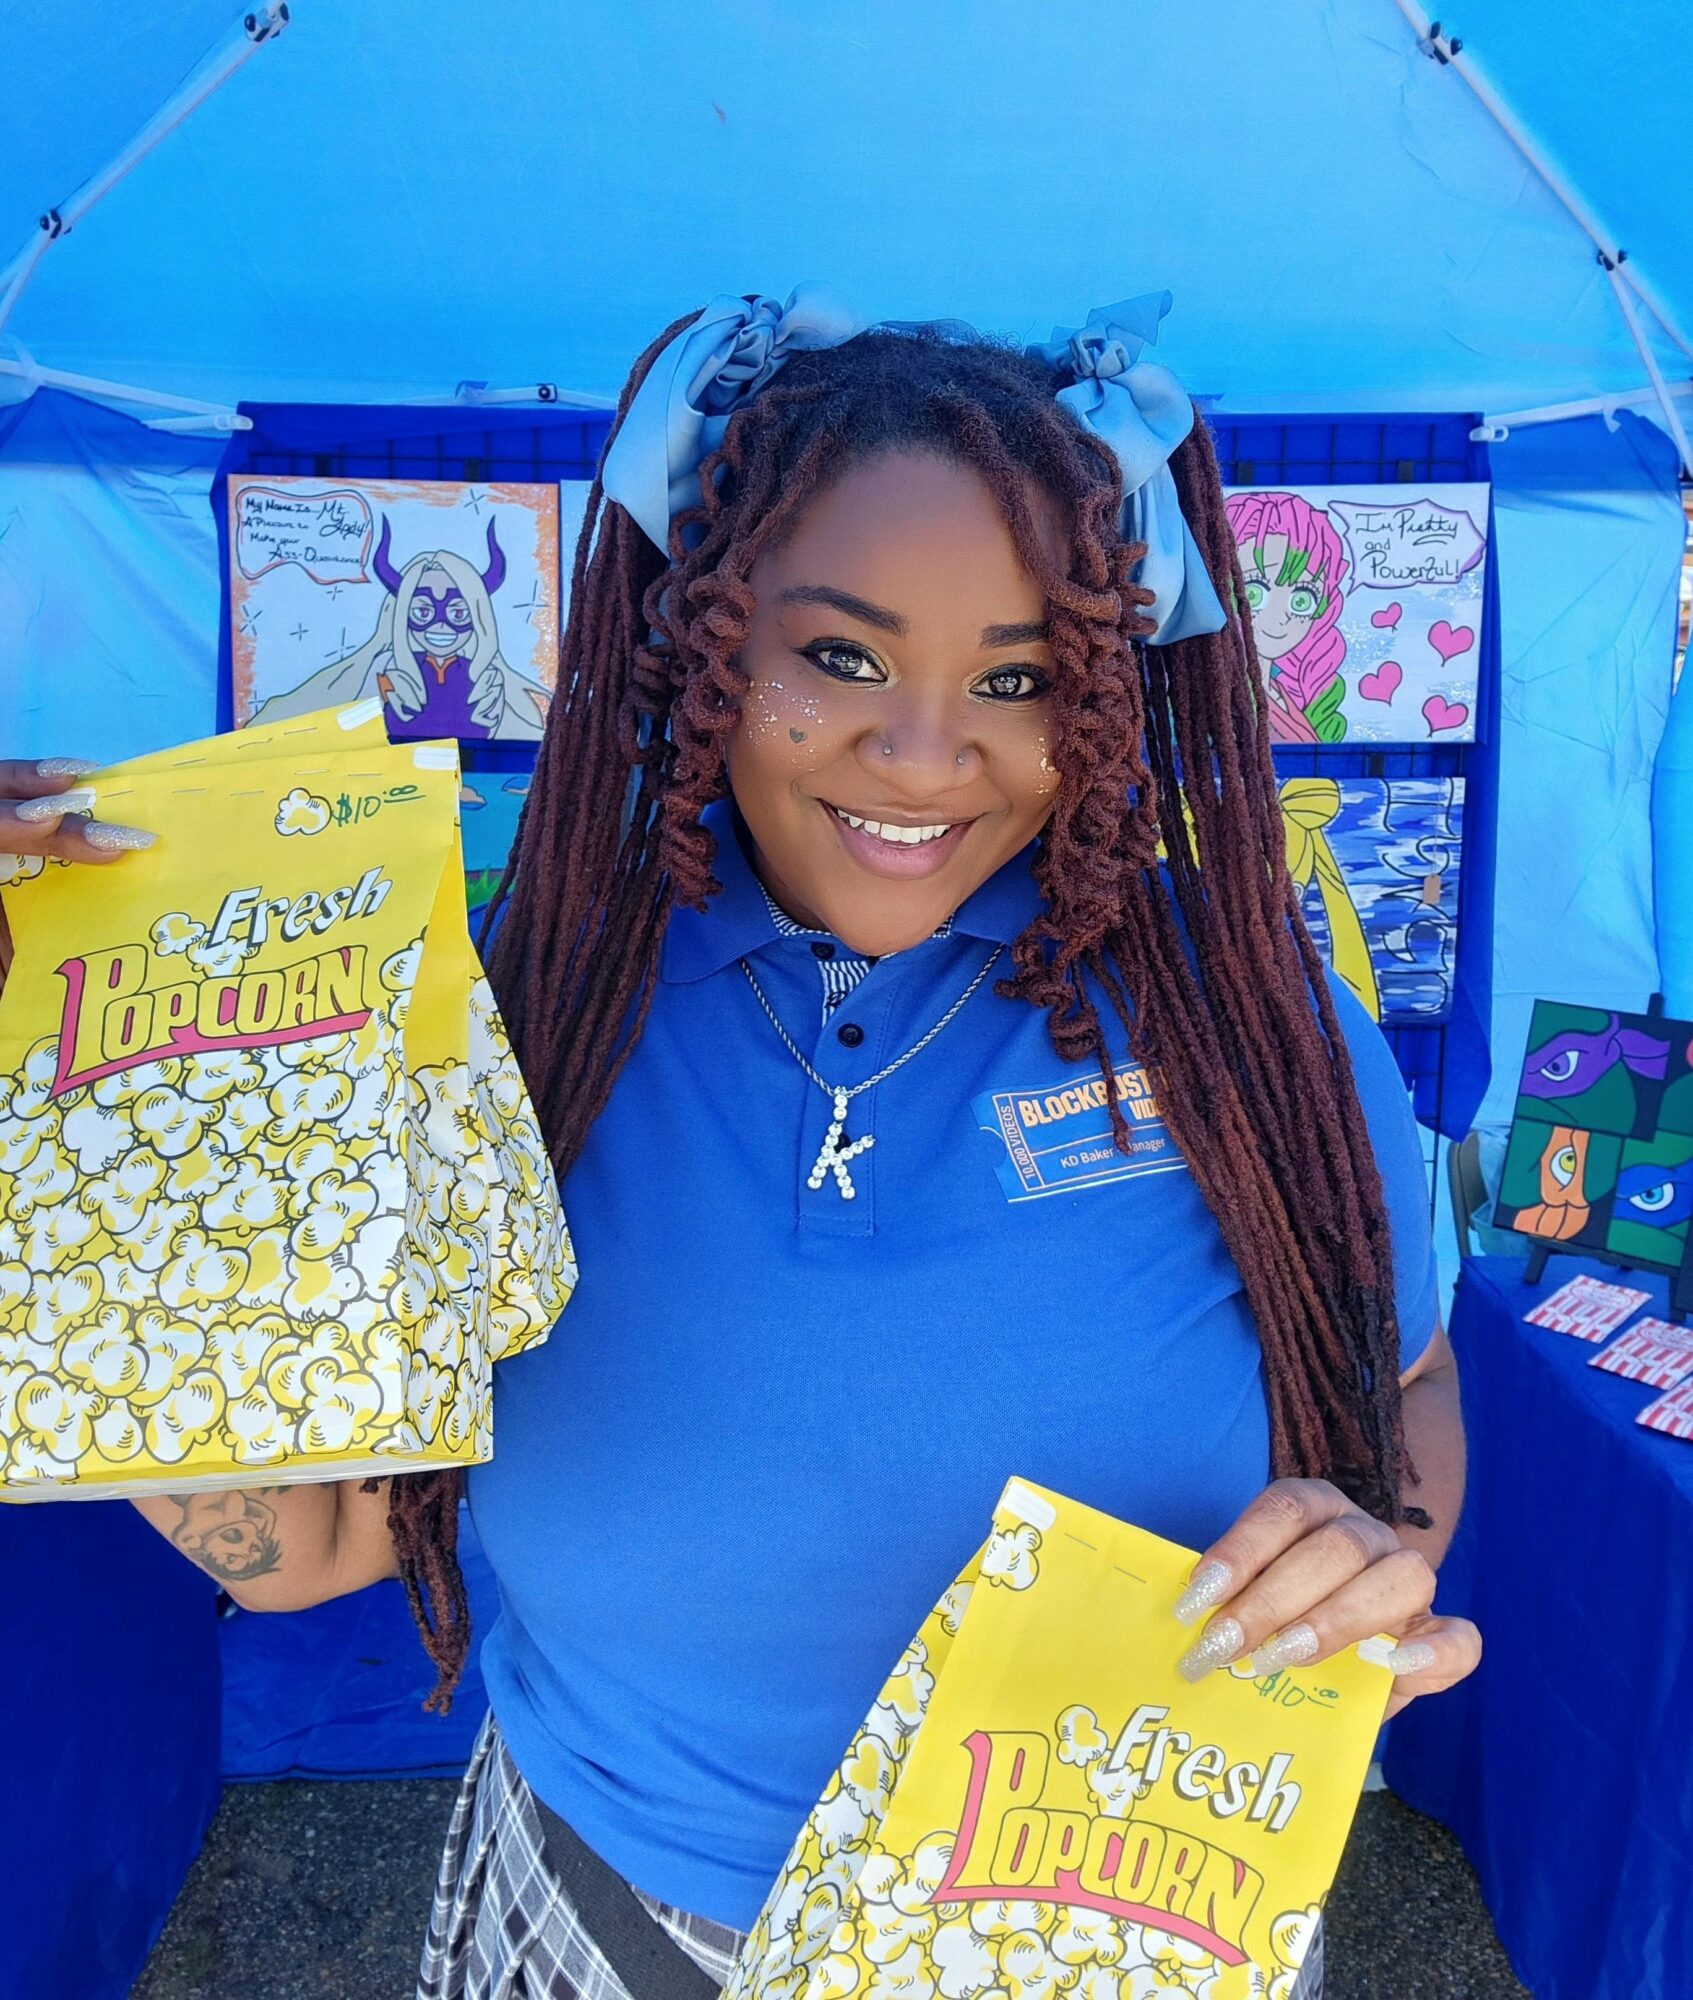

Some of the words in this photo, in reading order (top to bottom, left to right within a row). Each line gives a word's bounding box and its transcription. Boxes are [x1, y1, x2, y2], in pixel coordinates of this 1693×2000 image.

[245, 498, 263, 513] My
[265, 500, 295, 512] Name
[1393, 508, 1458, 540] Pretty
[1364, 537, 1391, 551] and
[1360, 550, 1460, 581] Powerful!
[206, 865, 393, 951] Fresh
[1018, 1066, 1168, 1128] BLOCKBUST
[1001, 1105, 1022, 1147] VIDEOS
[1013, 1147, 1036, 1179] 10,000
[1059, 1156, 1079, 1169] KD
[1081, 1147, 1114, 1165] Baker
[1127, 1138, 1166, 1152] anager
[1103, 1704, 1302, 1834] Fresh
